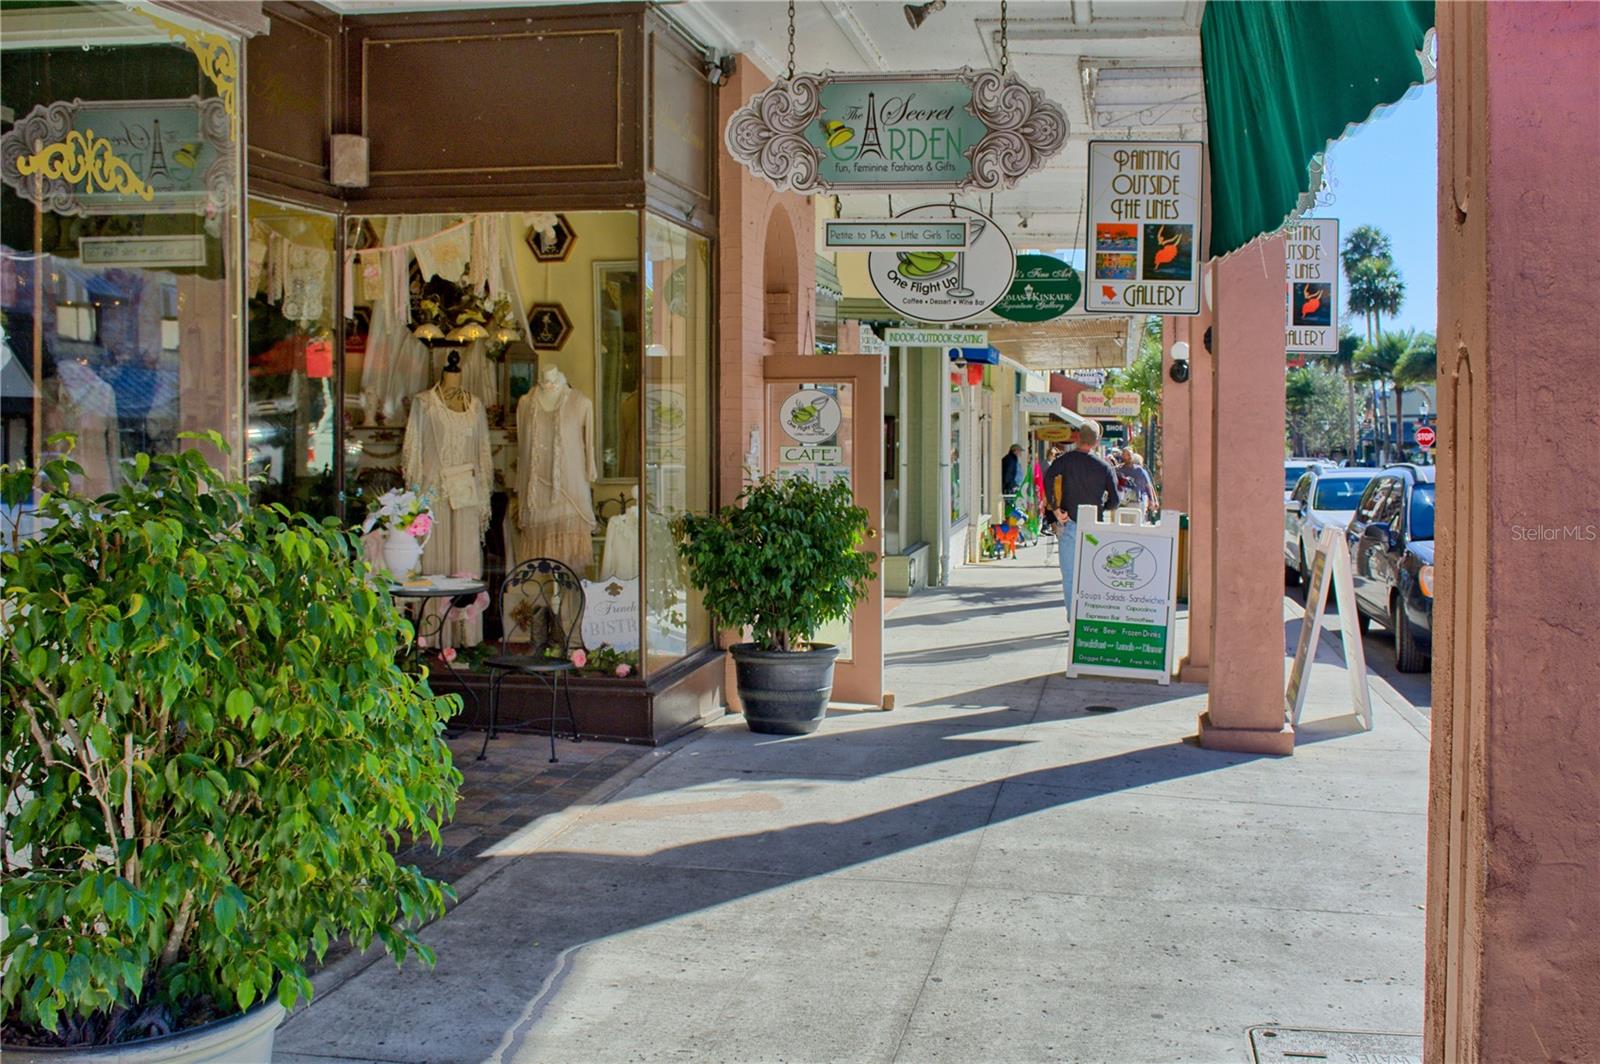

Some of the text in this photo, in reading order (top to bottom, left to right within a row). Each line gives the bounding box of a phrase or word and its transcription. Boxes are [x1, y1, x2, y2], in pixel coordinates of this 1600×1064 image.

[842, 93, 954, 124] The Secret
[935, 161, 956, 172] Gifts
[1113, 150, 1180, 172] PAINTING
[1112, 174, 1180, 196] OUTSIDE
[1111, 199, 1180, 221] THE LINES
[830, 229, 962, 240] Petite to Plus Little Girls Too
[1295, 263, 1321, 279] LINES
[887, 269, 959, 296] One Flight Up
[902, 297, 923, 305] Coffee
[1123, 284, 1185, 307] GALLERY
[1285, 330, 1326, 346] ALLERY
[1417, 433, 1435, 441] STOP
